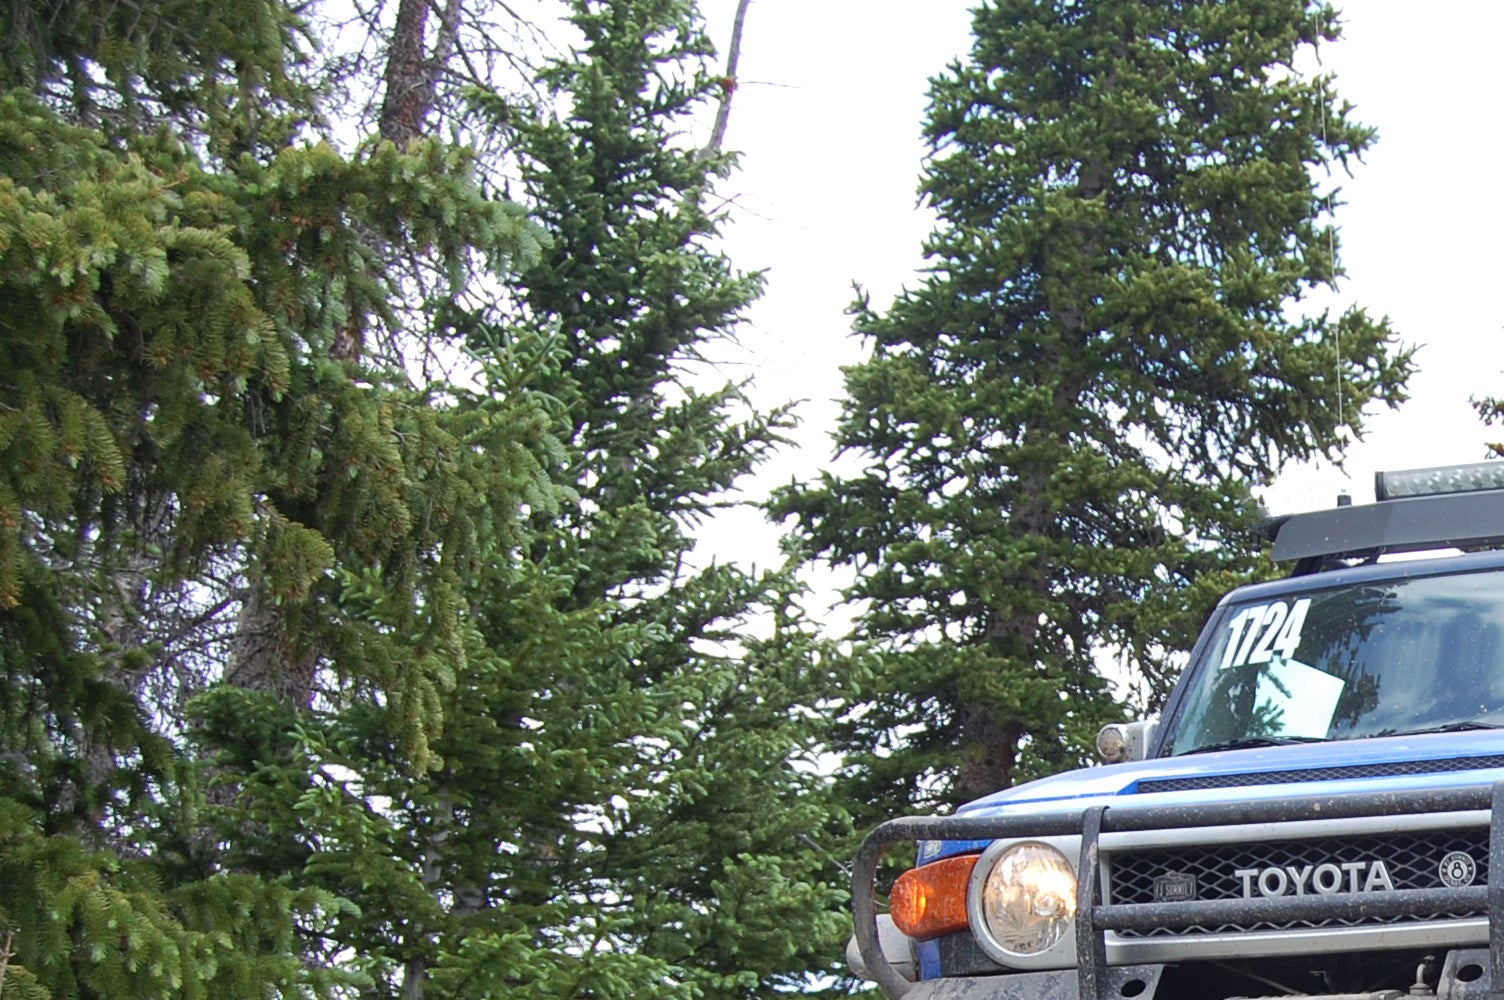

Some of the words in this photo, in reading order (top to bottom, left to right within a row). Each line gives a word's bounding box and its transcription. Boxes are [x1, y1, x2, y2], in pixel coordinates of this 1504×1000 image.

[1220, 599, 1312, 669] 1724
[1234, 860, 1394, 899] TOYOTA
[1451, 861, 1464, 879] 8
